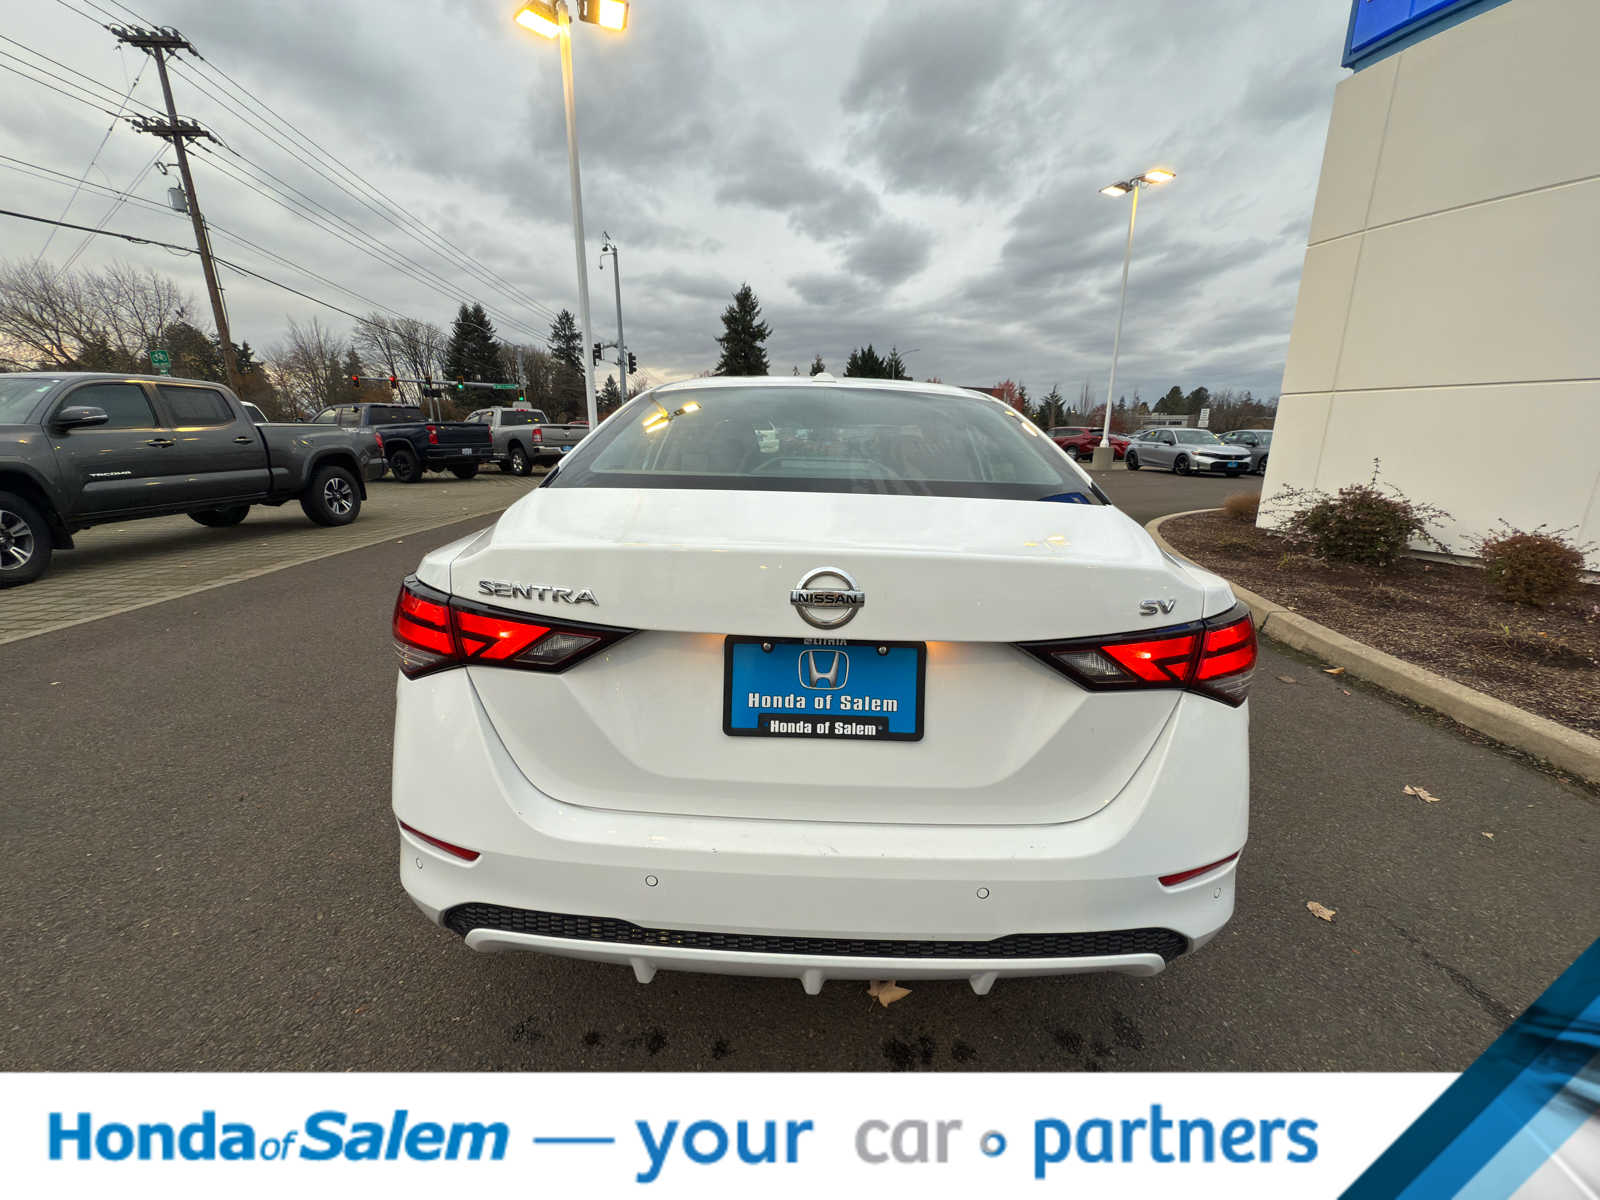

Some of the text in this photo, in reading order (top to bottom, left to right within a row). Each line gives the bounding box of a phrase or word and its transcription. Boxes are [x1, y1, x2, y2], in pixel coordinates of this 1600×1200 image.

[478, 579, 599, 606] SENTRA
[798, 592, 858, 604] NISSAN
[1139, 599, 1176, 616] SV
[748, 692, 898, 712] Honda of Salem
[770, 720, 877, 736] Honda of Salem
